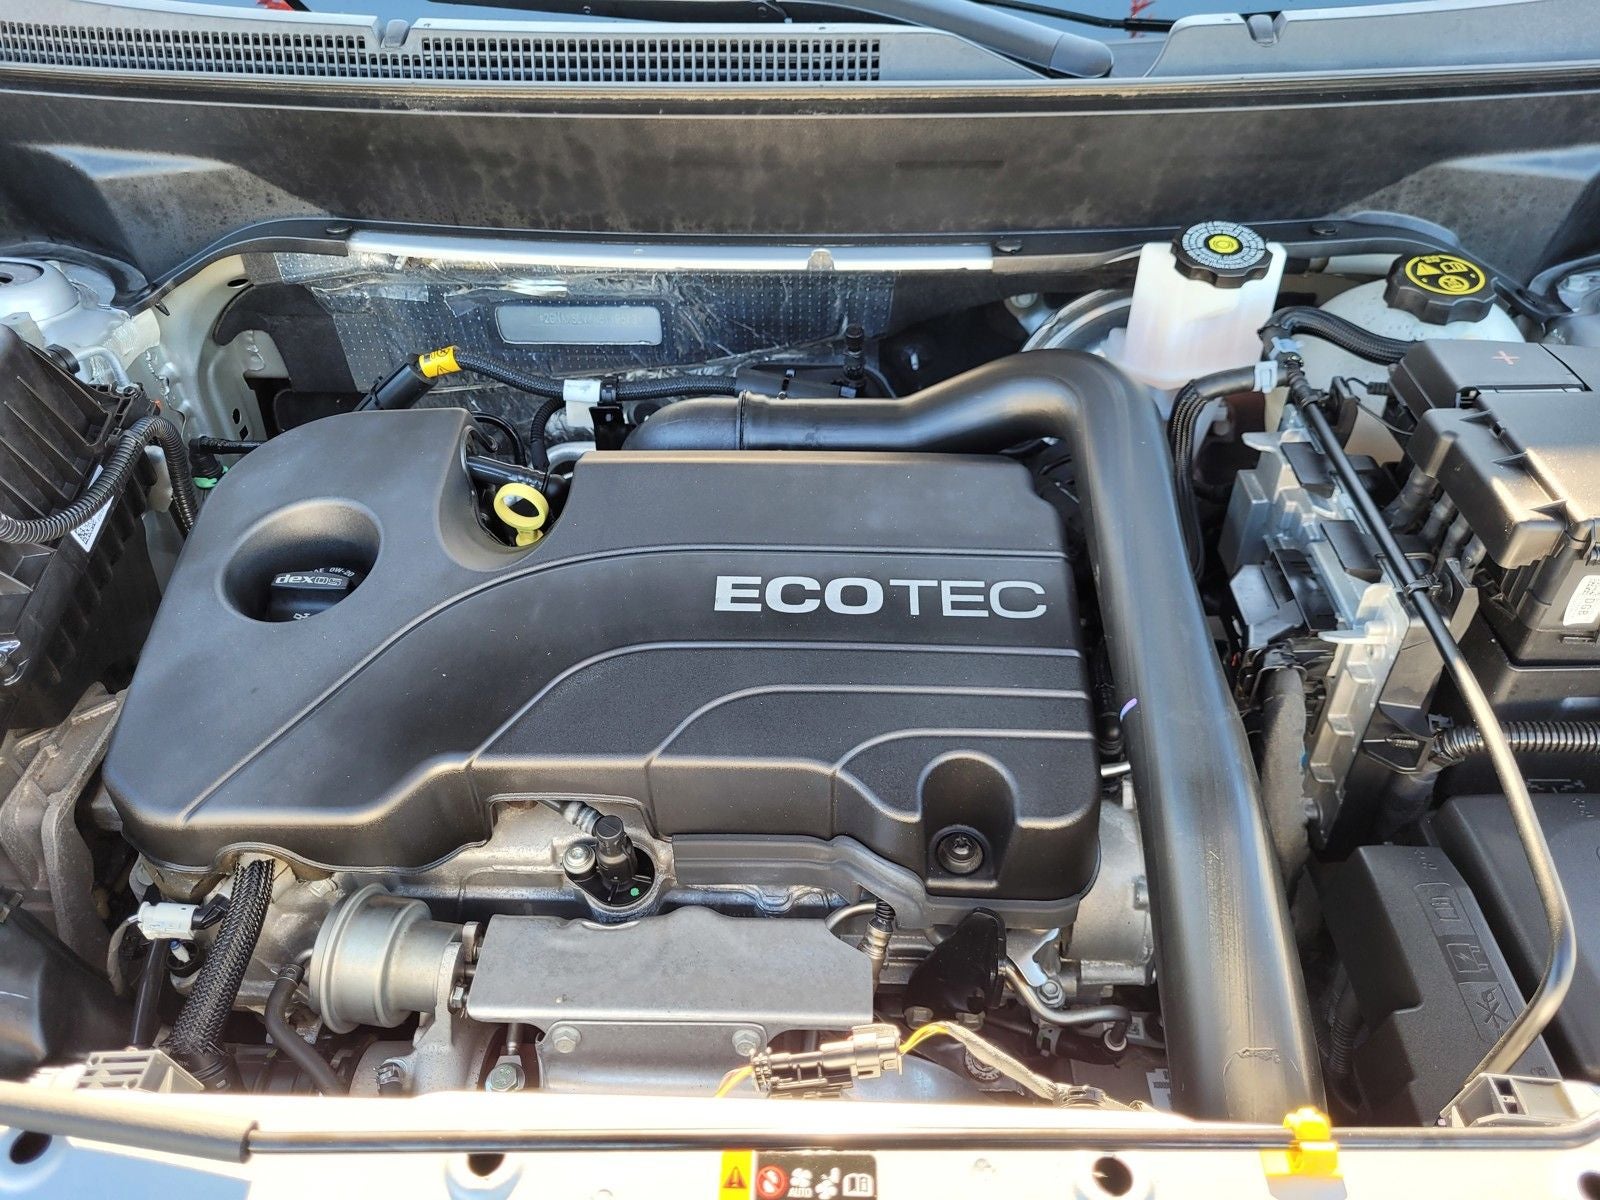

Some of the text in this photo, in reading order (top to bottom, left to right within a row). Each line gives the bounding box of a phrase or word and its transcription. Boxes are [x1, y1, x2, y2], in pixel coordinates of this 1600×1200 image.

[329, 566, 355, 577] 0W-20
[275, 574, 343, 587] dexos
[714, 575, 1047, 619] ECOTEC
